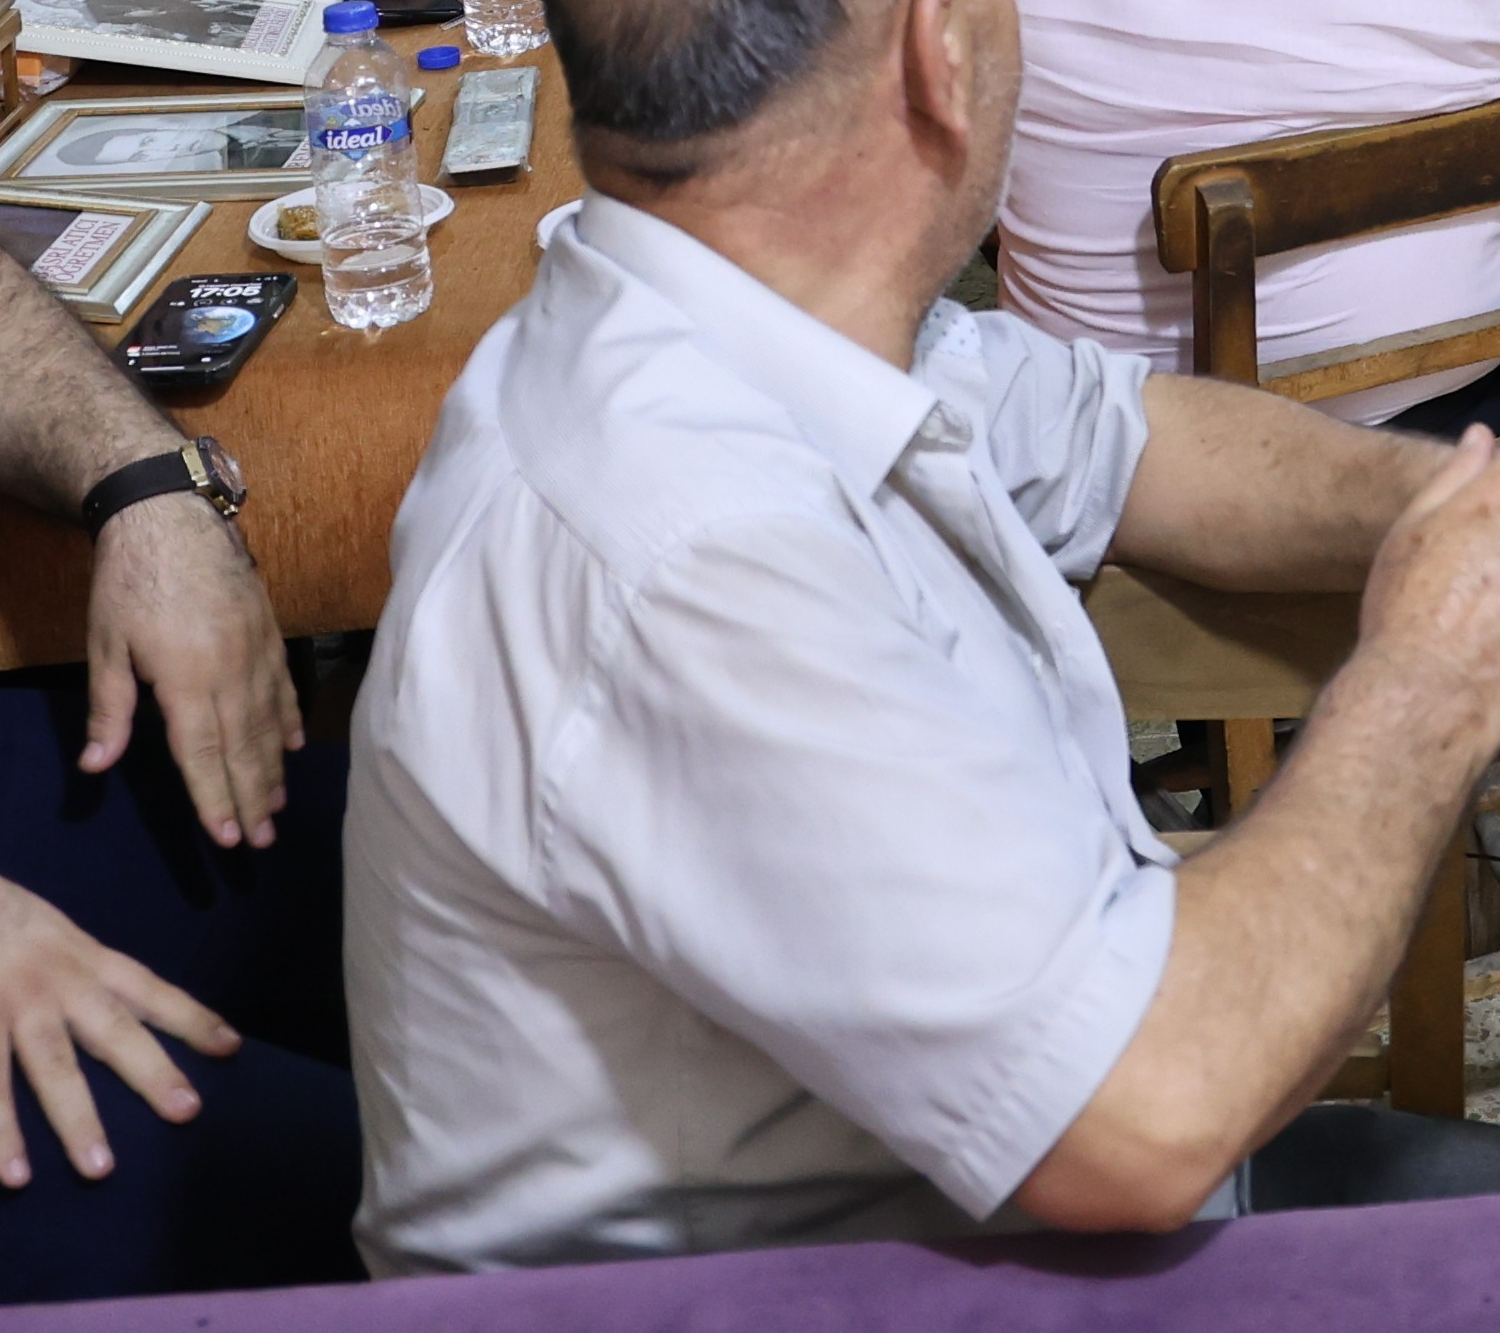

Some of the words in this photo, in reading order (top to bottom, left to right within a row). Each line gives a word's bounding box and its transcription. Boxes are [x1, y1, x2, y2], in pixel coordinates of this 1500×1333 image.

[326, 126, 385, 150] ideal
[64, 218, 100, 249] ATICI
[190, 286, 262, 298] 17:05
